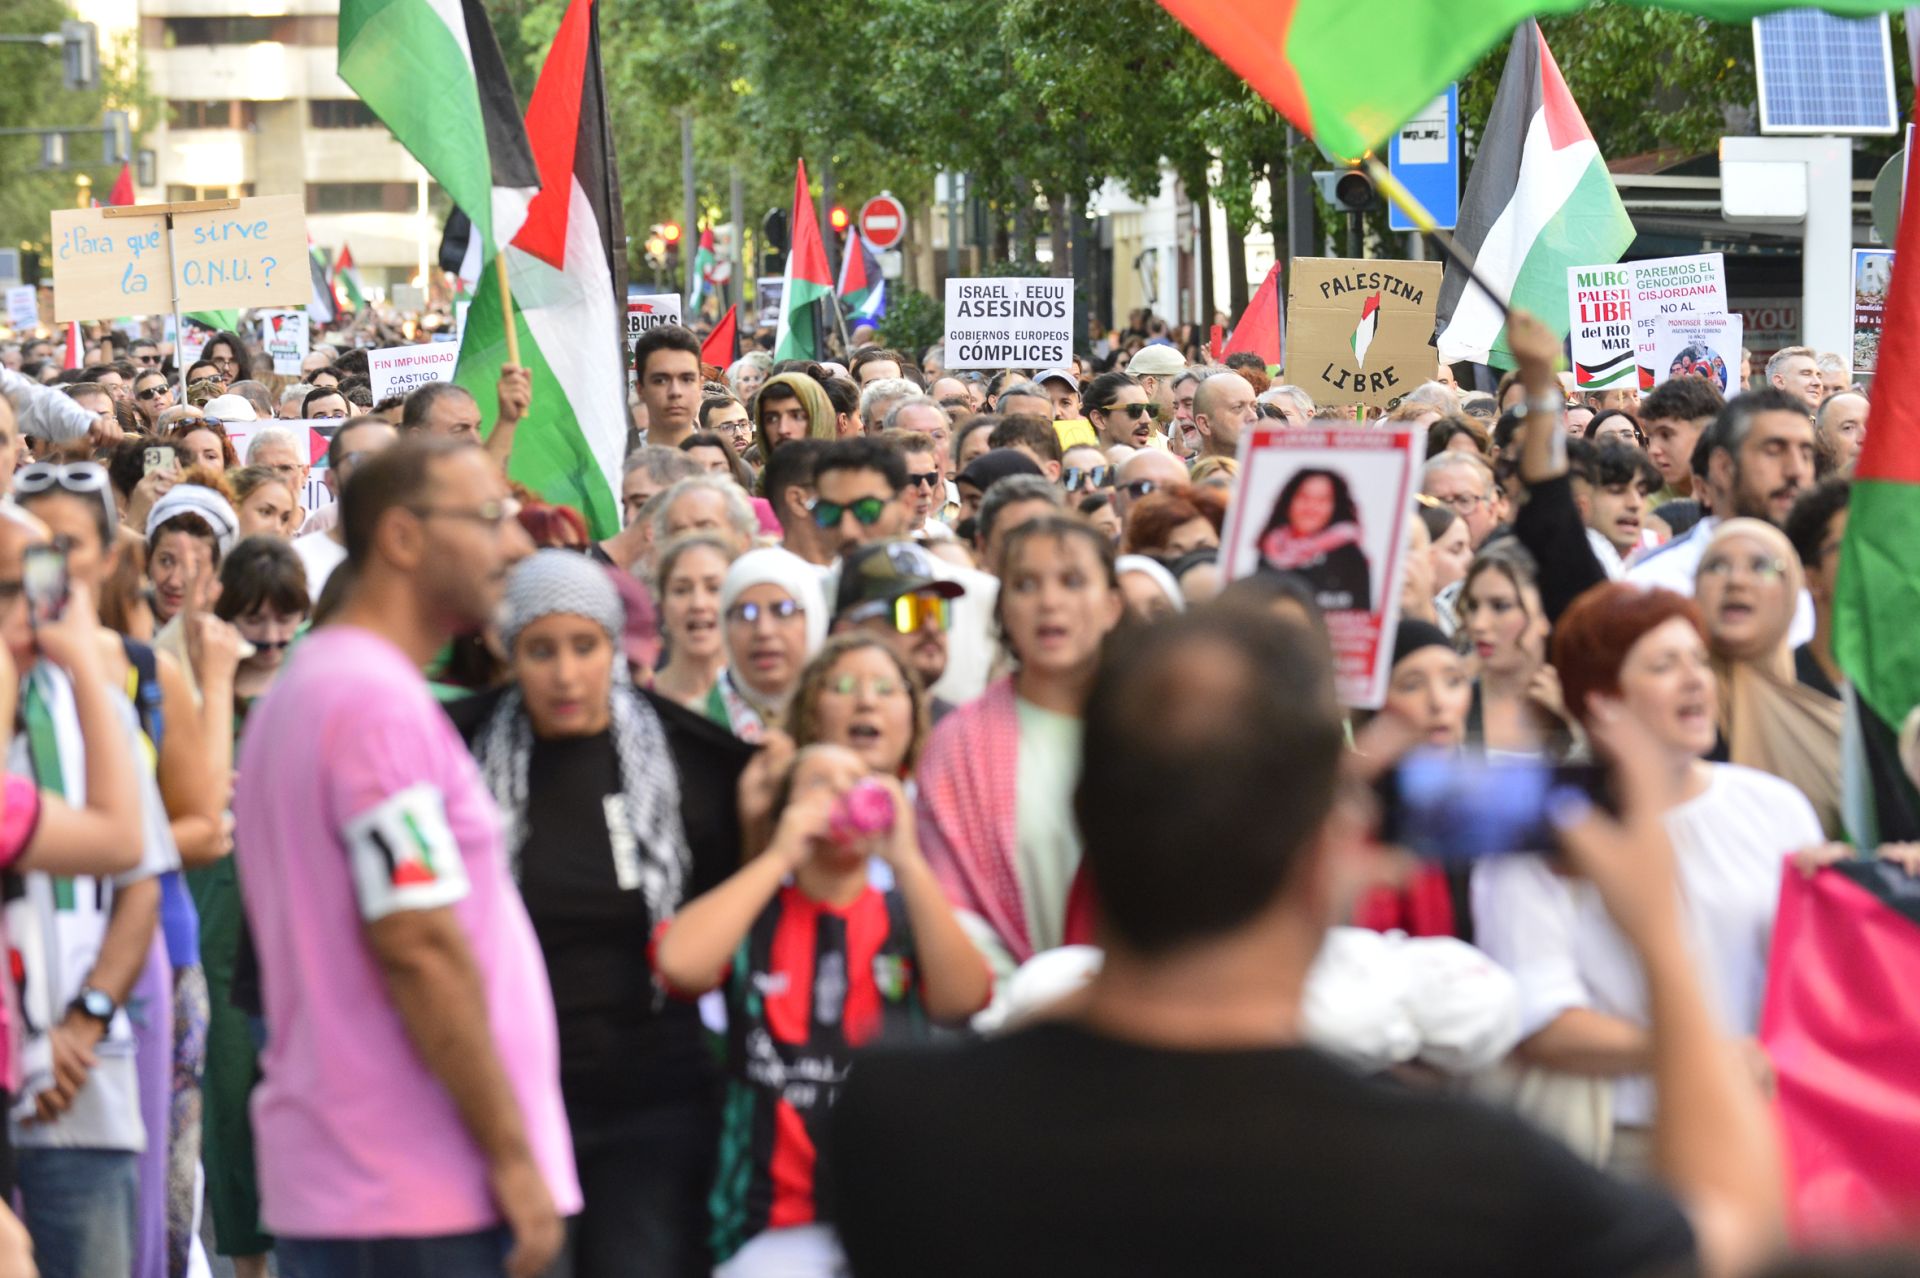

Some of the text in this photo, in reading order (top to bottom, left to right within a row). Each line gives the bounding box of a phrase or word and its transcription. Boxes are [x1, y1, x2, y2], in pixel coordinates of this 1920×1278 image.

[127, 223, 160, 258] qué
[194, 219, 269, 244] sirve
[121, 262, 149, 294] la
[1635, 262, 1715, 279] PAREMOS EL
[1320, 272, 1423, 305] PALESTINA
[1636, 274, 1715, 290] GENOCIDIO EN
[959, 285, 1009, 298] ISRAEL
[1026, 286, 1064, 299] EEUU
[1638, 284, 1717, 301] CISJORDANIA
[957, 300, 1066, 318] ASESINOS
[1660, 301, 1695, 314] NO AL
[950, 330, 1069, 341] GOBIERNOS EUROPEOS
[1582, 322, 1630, 338] del RÍO
[959, 340, 1063, 361] CÓMPLICES
[1602, 338, 1630, 350] MAR
[374, 353, 454, 369] FIN IMPUNIDAD
[390, 372, 438, 385] CASTIGO
[1322, 363, 1399, 392] LIBRE
